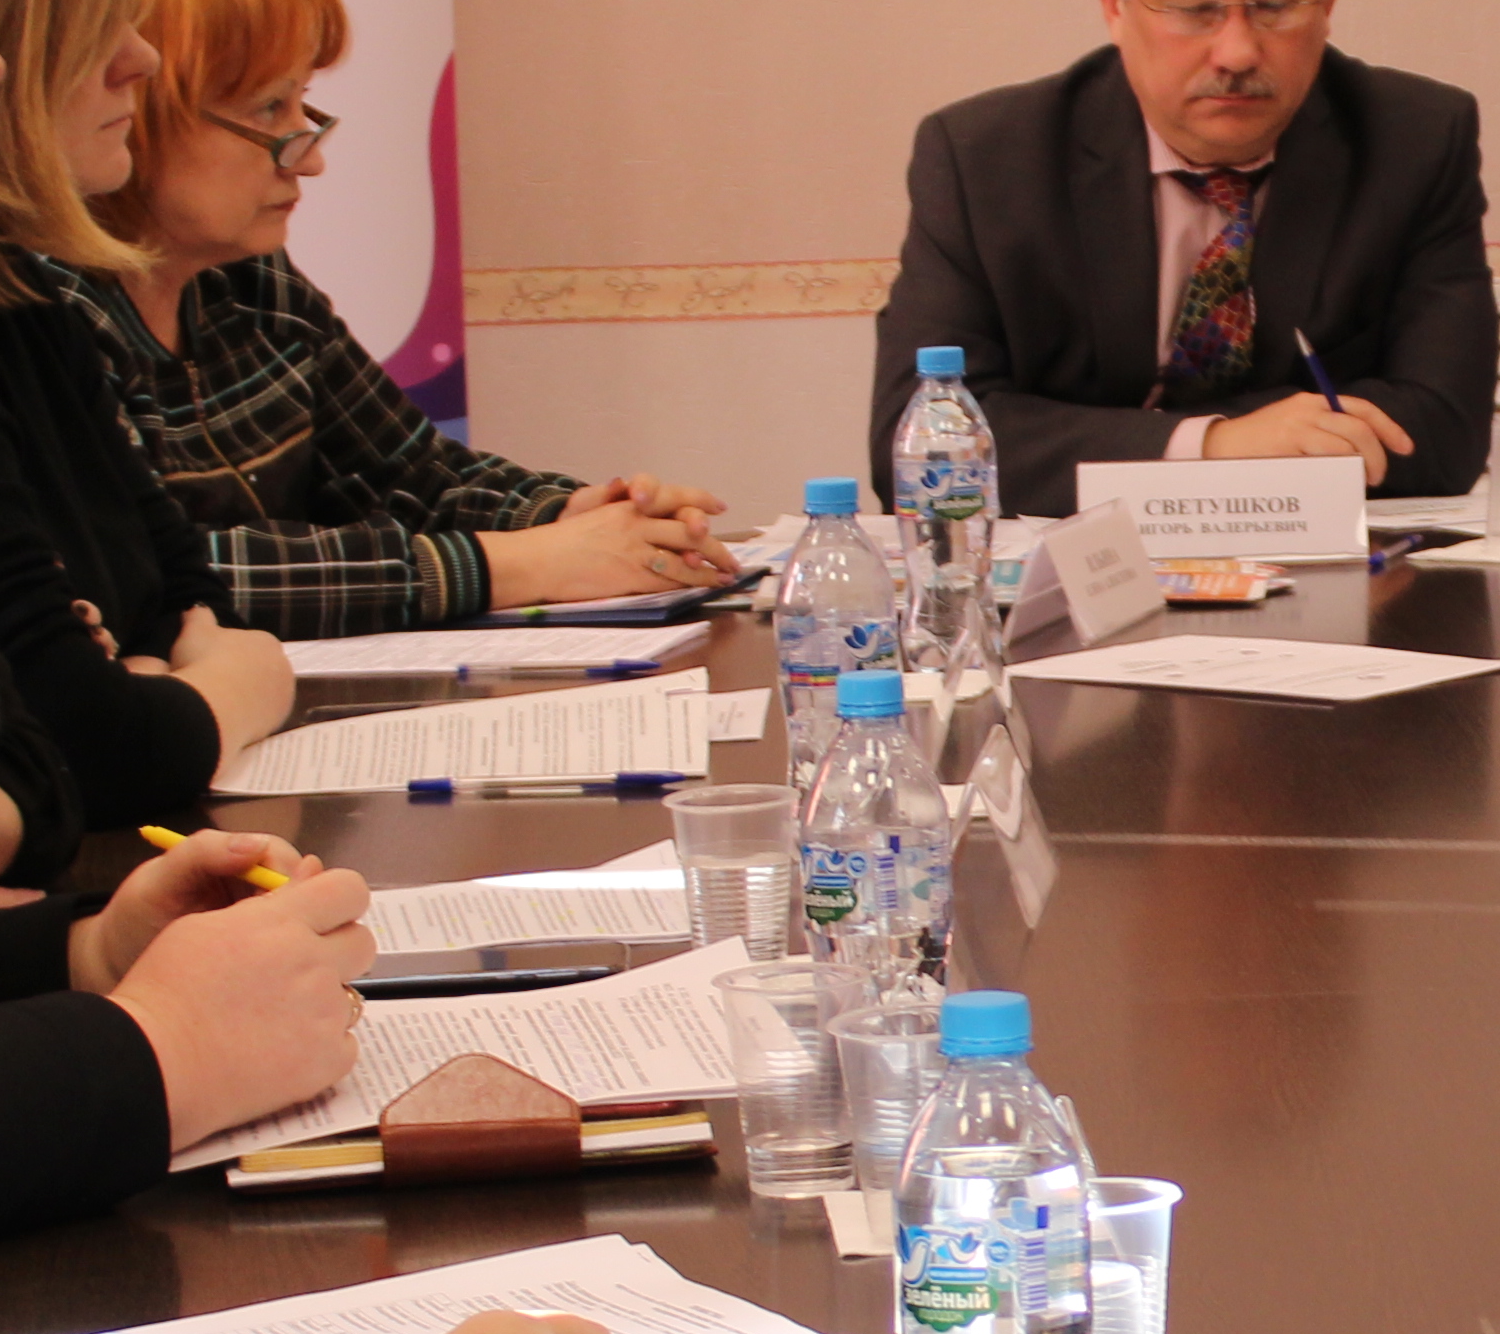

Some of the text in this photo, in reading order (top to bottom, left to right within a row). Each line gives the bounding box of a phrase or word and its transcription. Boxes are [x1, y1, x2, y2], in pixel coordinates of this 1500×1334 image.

[1144, 496, 1301, 516] СВЕТУШКОВ
[1138, 519, 1308, 535] ИГОРЬ ВАЛЕРЬЕВИЧ
